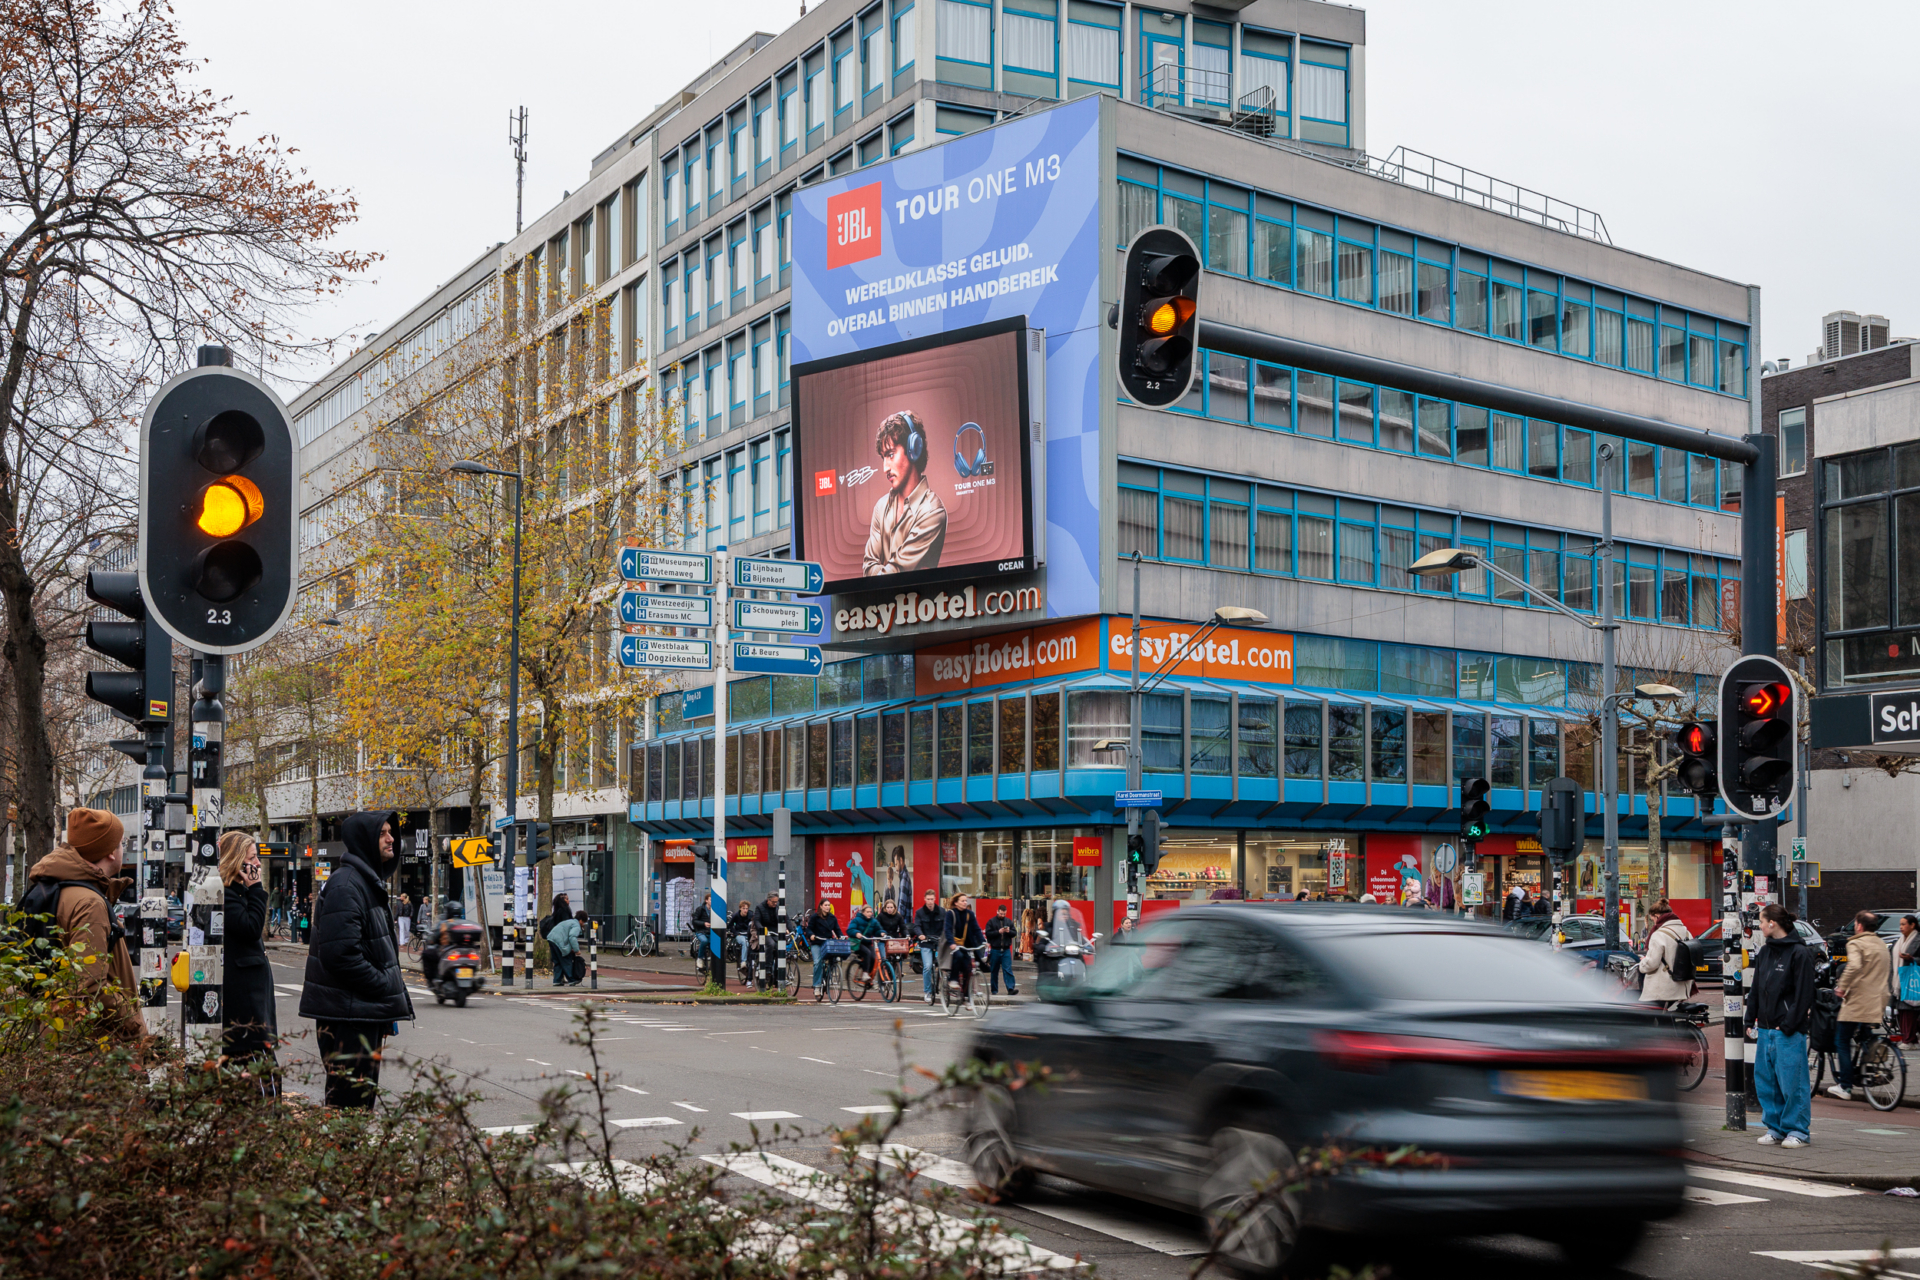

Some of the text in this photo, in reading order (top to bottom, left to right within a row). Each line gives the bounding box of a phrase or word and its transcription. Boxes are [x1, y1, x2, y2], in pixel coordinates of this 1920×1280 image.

[896, 153, 1061, 225] TOUR ONE M3
[845, 242, 1033, 305] WERELDKLASSE GELUID.
[827, 263, 1059, 337] OVERAL BINNEN HANDBEREIK
[1146, 381, 1160, 390] 2.2
[819, 476, 833, 490] JBL
[954, 478, 996, 491] TOUR ONE M3
[659, 557, 705, 569] Museumpark
[998, 560, 1024, 572] OCEAN
[650, 568, 694, 579] Wytemaweg
[752, 564, 783, 574] Lijnbaan
[752, 575, 786, 585] Bijenkorf
[650, 598, 695, 609] Westzeedijk
[752, 606, 799, 617] Schouwburg-
[835, 585, 1042, 634] easyHotel.com
[207, 609, 232, 624] 2.3
[648, 611, 679, 620] Erasmus
[680, 612, 692, 621] MC
[781, 619, 799, 628] plein
[650, 642, 690, 651] Westblaak
[759, 648, 780, 656] Beurs
[1111, 632, 1291, 670] easyHotel.com
[648, 653, 709, 665] Oogziekenhuis
[933, 634, 1077, 684] easyHotel.com
[736, 841, 758, 857] wibra
[1077, 847, 1099, 855] wibra
[821, 881, 834, 889] topper
[821, 890, 842, 898] Nederland
